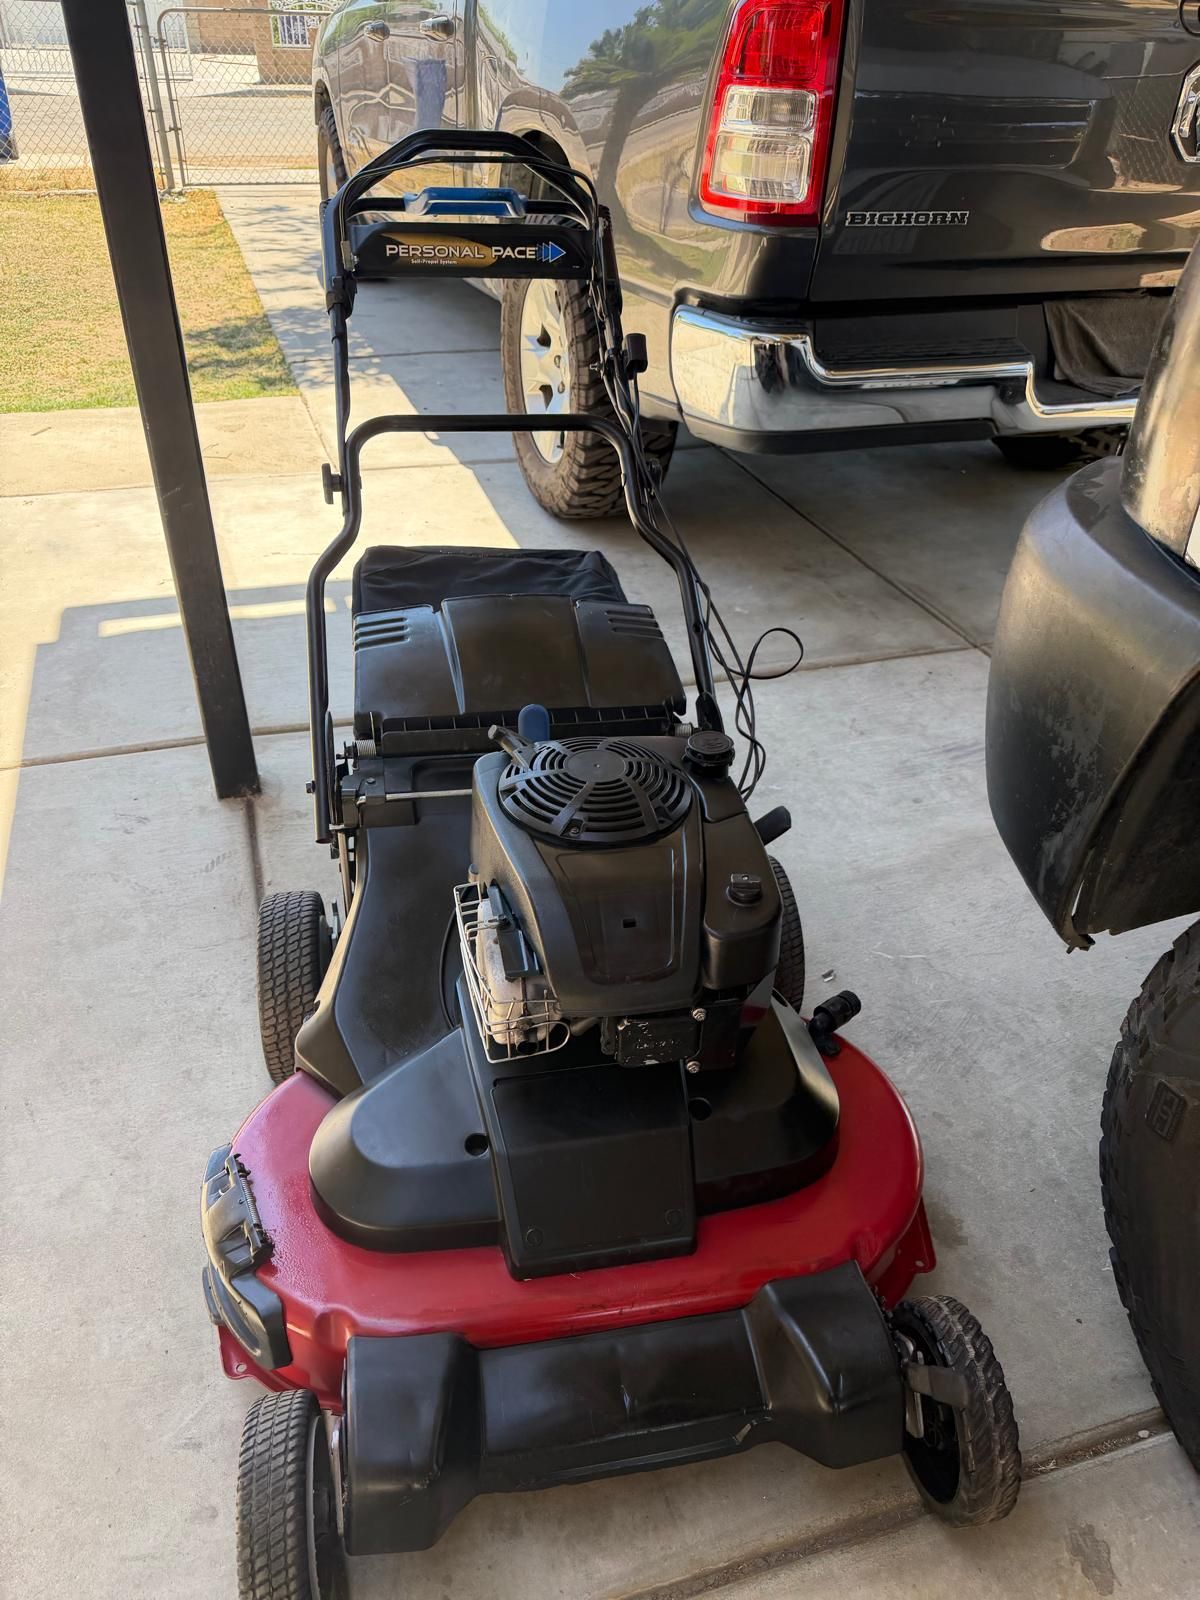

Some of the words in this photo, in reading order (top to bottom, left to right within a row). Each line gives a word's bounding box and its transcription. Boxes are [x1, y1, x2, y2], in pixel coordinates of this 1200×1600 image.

[845, 211, 970, 226] BIGHORN
[385, 244, 484, 258] PERSONAL
[491, 246, 536, 259] PACE
